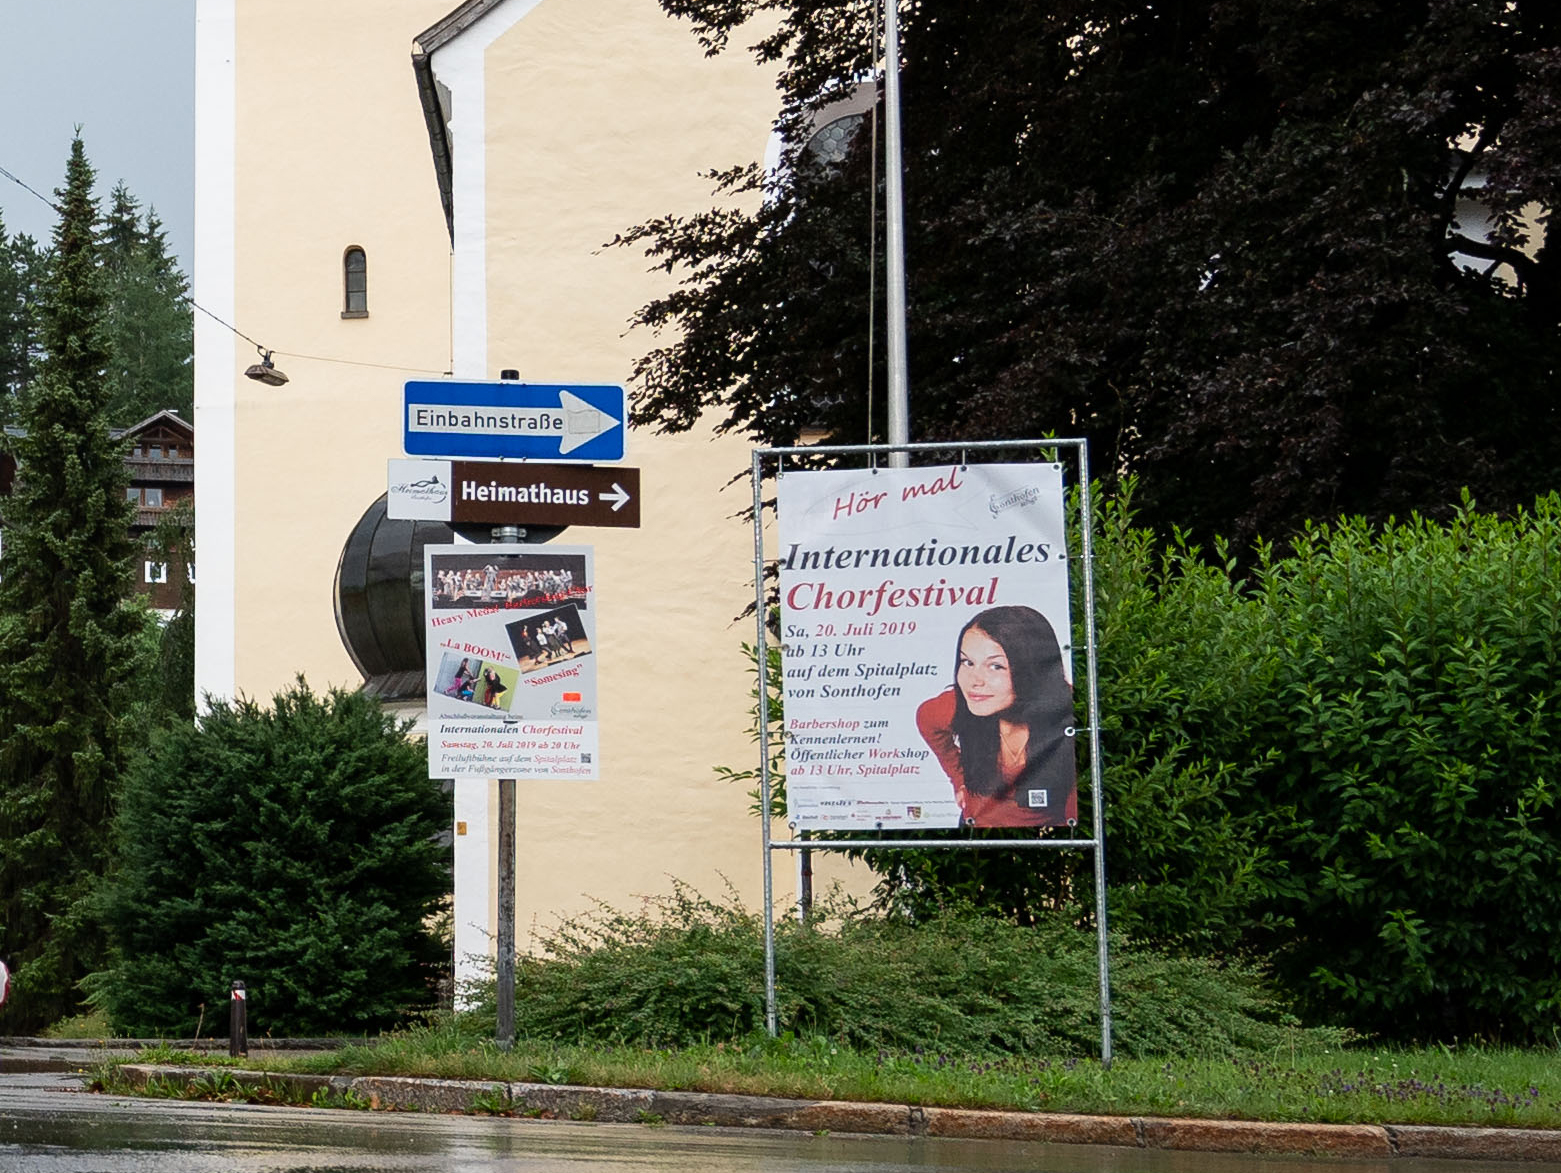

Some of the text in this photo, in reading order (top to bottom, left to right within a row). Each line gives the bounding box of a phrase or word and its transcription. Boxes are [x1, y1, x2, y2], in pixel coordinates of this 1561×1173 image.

[416, 409, 564, 430] Einbahnstraße
[462, 481, 589, 505] Heimathaus
[832, 466, 963, 521] Hör mal
[782, 536, 1051, 571] Internationales
[786, 577, 999, 616] Chorfestival
[431, 614, 464, 628] Heavy
[785, 621, 917, 639] Sa, 20. Juli 2019
[785, 643, 865, 658] ab 13 Uhr
[787, 662, 938, 681] auf dem Spitalplatz
[788, 683, 901, 701] von Sonthofen
[440, 724, 584, 736] Internationalen Chorfestival
[790, 718, 889, 732] Barbershop zum
[440, 740, 580, 750] Samstag, 20. Juli 2019 ab 20 Uhr
[790, 733, 882, 745] Kennenlernen!
[498, 754, 513, 764] auf
[514, 754, 532, 762] dem
[534, 754, 577, 764] Spitalplatz
[790, 748, 929, 762] Öffentlicher Workshop
[441, 764, 450, 773] in
[451, 764, 466, 773] der
[550, 764, 592, 775] Sonthofen
[790, 763, 920, 778] ab 13 Uhr, Spitalplatz
